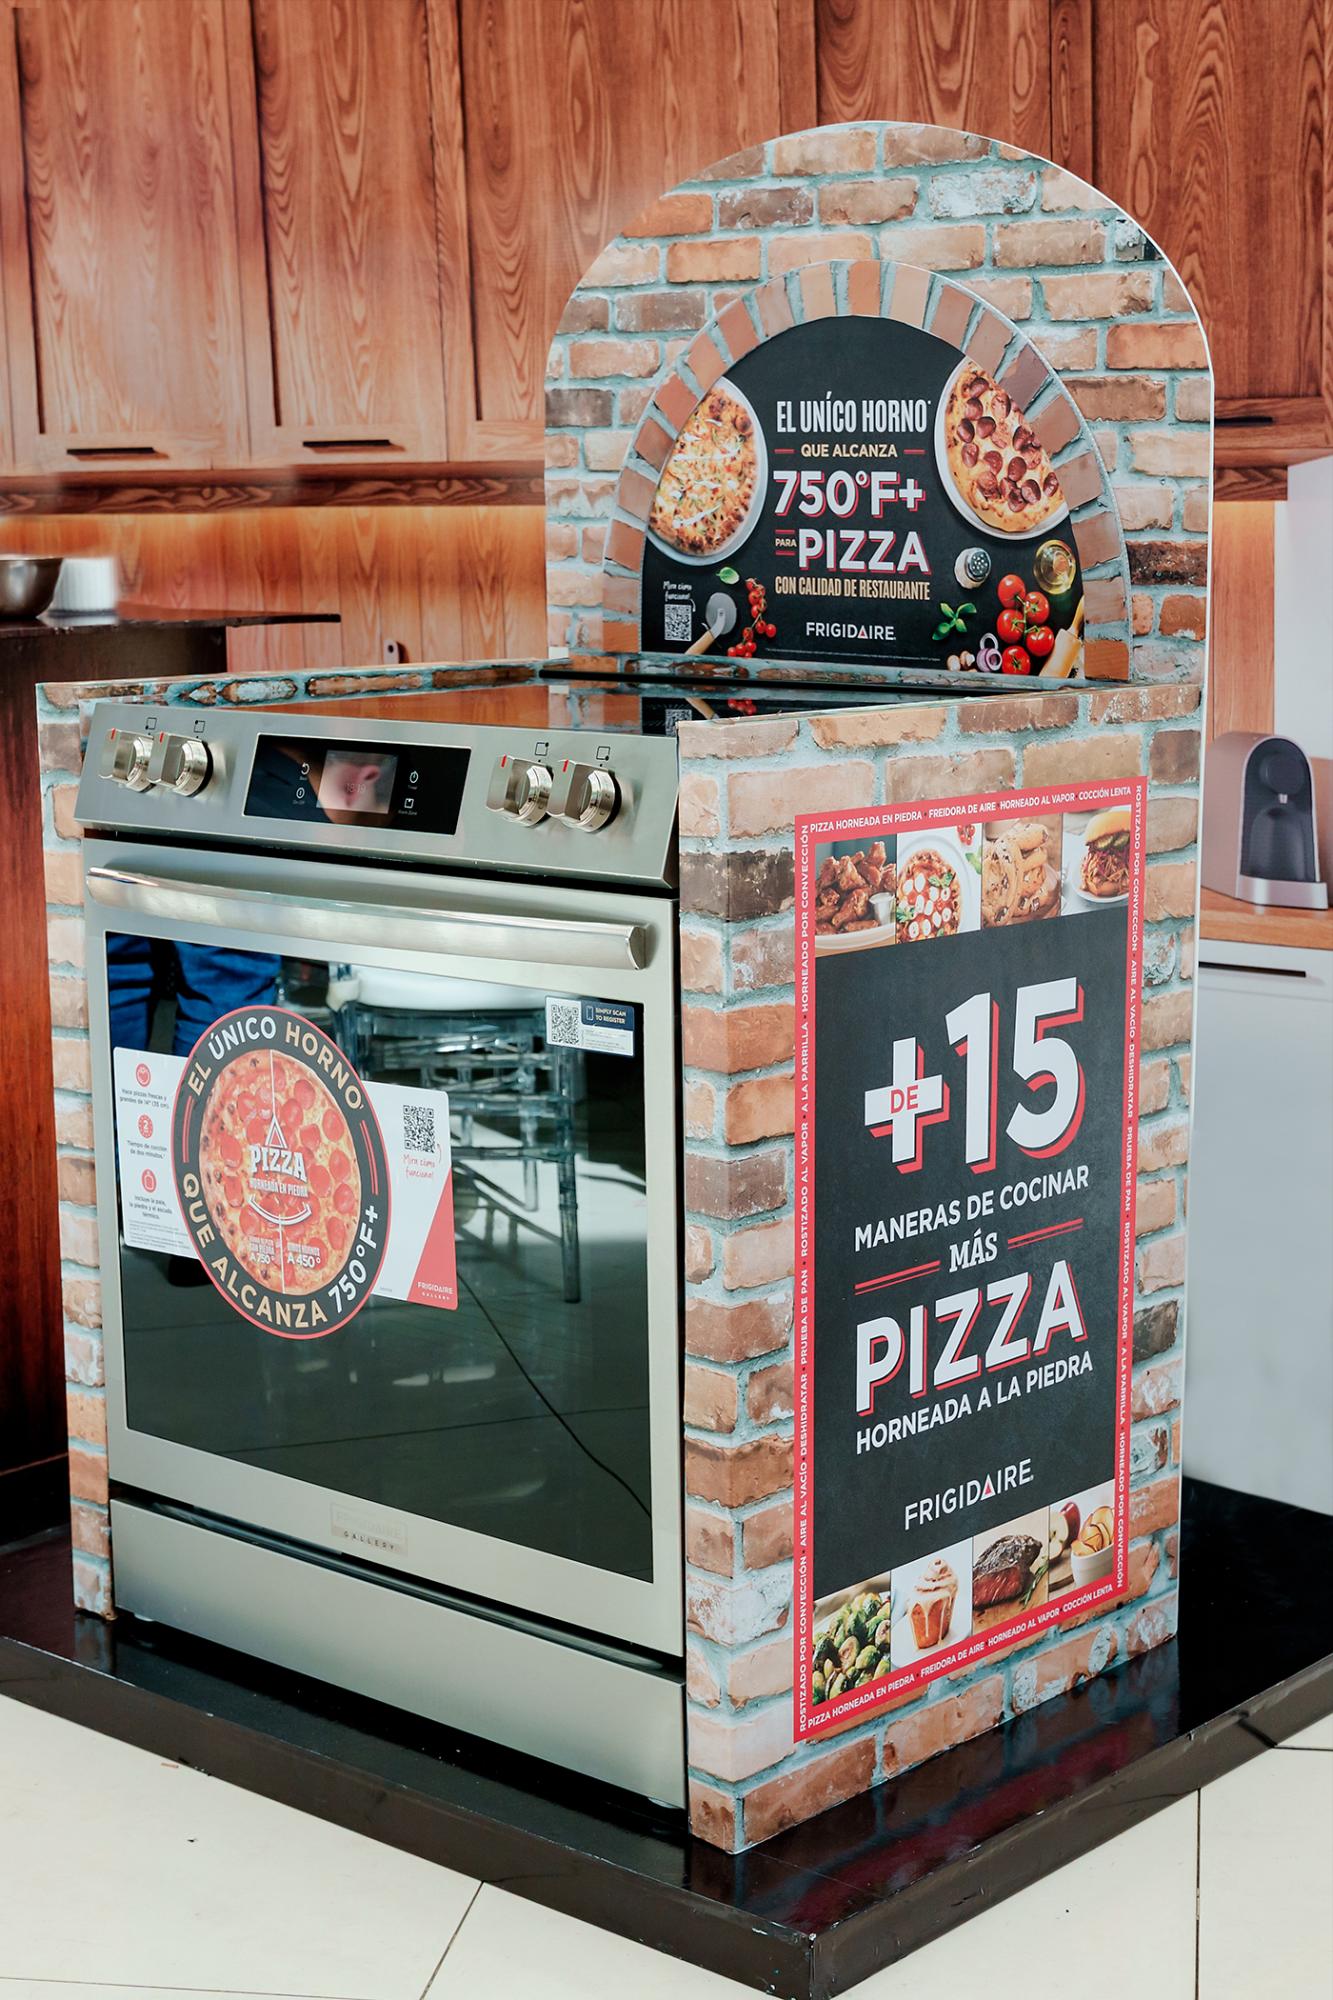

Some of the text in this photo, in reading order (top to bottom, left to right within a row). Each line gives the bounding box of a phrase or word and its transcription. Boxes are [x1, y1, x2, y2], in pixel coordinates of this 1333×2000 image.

[776, 400, 796, 433] EL
[800, 391, 857, 433] UNÍCO
[801, 444, 898, 458] QUE ALCANZA
[773, 470, 926, 518] 750°F+
[775, 538, 797, 547] PARA
[798, 528, 932, 575] PIZZA
[775, 576, 931, 601] CON CALIDAD DE RESTAURANTE
[806, 622, 896, 641] FRIGIDAIRE
[928, 801, 997, 818] FREIDORA DE AIRE
[1000, 792, 1076, 810] HORNEADO AL VAPOR
[1079, 786, 1132, 801] COCCIÓN LENTA
[809, 810, 923, 833] PIZZA HORNEADA EN PIEDRA
[1131, 785, 1142, 952] ROSTIZADO POR CONVECCIÓN
[800, 825, 809, 1012] HORNEADO POR CONVECCIÓN
[612, 1009, 627, 1017] SCAN
[1130, 988, 1137, 1003] AL
[1129, 1005, 1137, 1039] VACÍO
[187, 1064, 212, 1096] EL
[208, 1016, 277, 1060] ÚNICO
[801, 1023, 809, 1113] A LA PARRILLA
[864, 977, 1086, 1174] +15
[890, 1084, 919, 1115] DE
[1127, 1043, 1136, 1119] DESHIDRATAR
[143, 1118, 149, 1130] 2
[250, 1143, 307, 1183] PIZZA
[801, 1166, 808, 1184] AL
[1124, 1127, 1133, 1213] PRUEBA DE PAN
[279, 1183, 287, 1195] EN
[287, 1184, 309, 1198] PIEDRA
[855, 1165, 1089, 1252] MANERAS DE COCINAR
[183, 1172, 216, 1249] QUE
[212, 1256, 328, 1328] ALCANZA
[328, 1204, 379, 1314] 750°F+
[287, 1252, 321, 1268] A 450°
[949, 1227, 998, 1273] MÁS
[1122, 1221, 1131, 1285] ROSTIZADO
[417, 1281, 454, 1294] FRIGIDAIRE
[421, 1291, 450, 1300] GALLERY
[801, 1296, 808, 1315] DE
[1121, 1288, 1129, 1303] AL
[800, 1317, 808, 1365] PRUEBA
[856, 1259, 1089, 1416] PIZZA
[856, 1350, 1093, 1455] HORNEADA A LA PIEDRA
[1118, 1347, 1128, 1426] A LA PARRILLA
[800, 1373, 808, 1457] DESHIDRATAR
[799, 1462, 808, 1500] VACÍO
[905, 1458, 1034, 1530] FRIGIDAIRE
[800, 1502, 807, 1517] AL
[1116, 1432, 1126, 1589] HORNEADO POR CONVECCIÓN
[343, 1530, 394, 1550] GALLERY
[799, 1555, 807, 1635] CONVECCIÓN
[1062, 1584, 1114, 1613] COCCIÓN LENTA
[988, 1607, 1060, 1647] HORNEADO AL VAPOR
[920, 1641, 985, 1678] FREIDORA DE AIRE
[799, 1664, 807, 1732] ROSTIZADO
[807, 1674, 915, 1728] PIZZA HORNEADA EN PIEDRA
